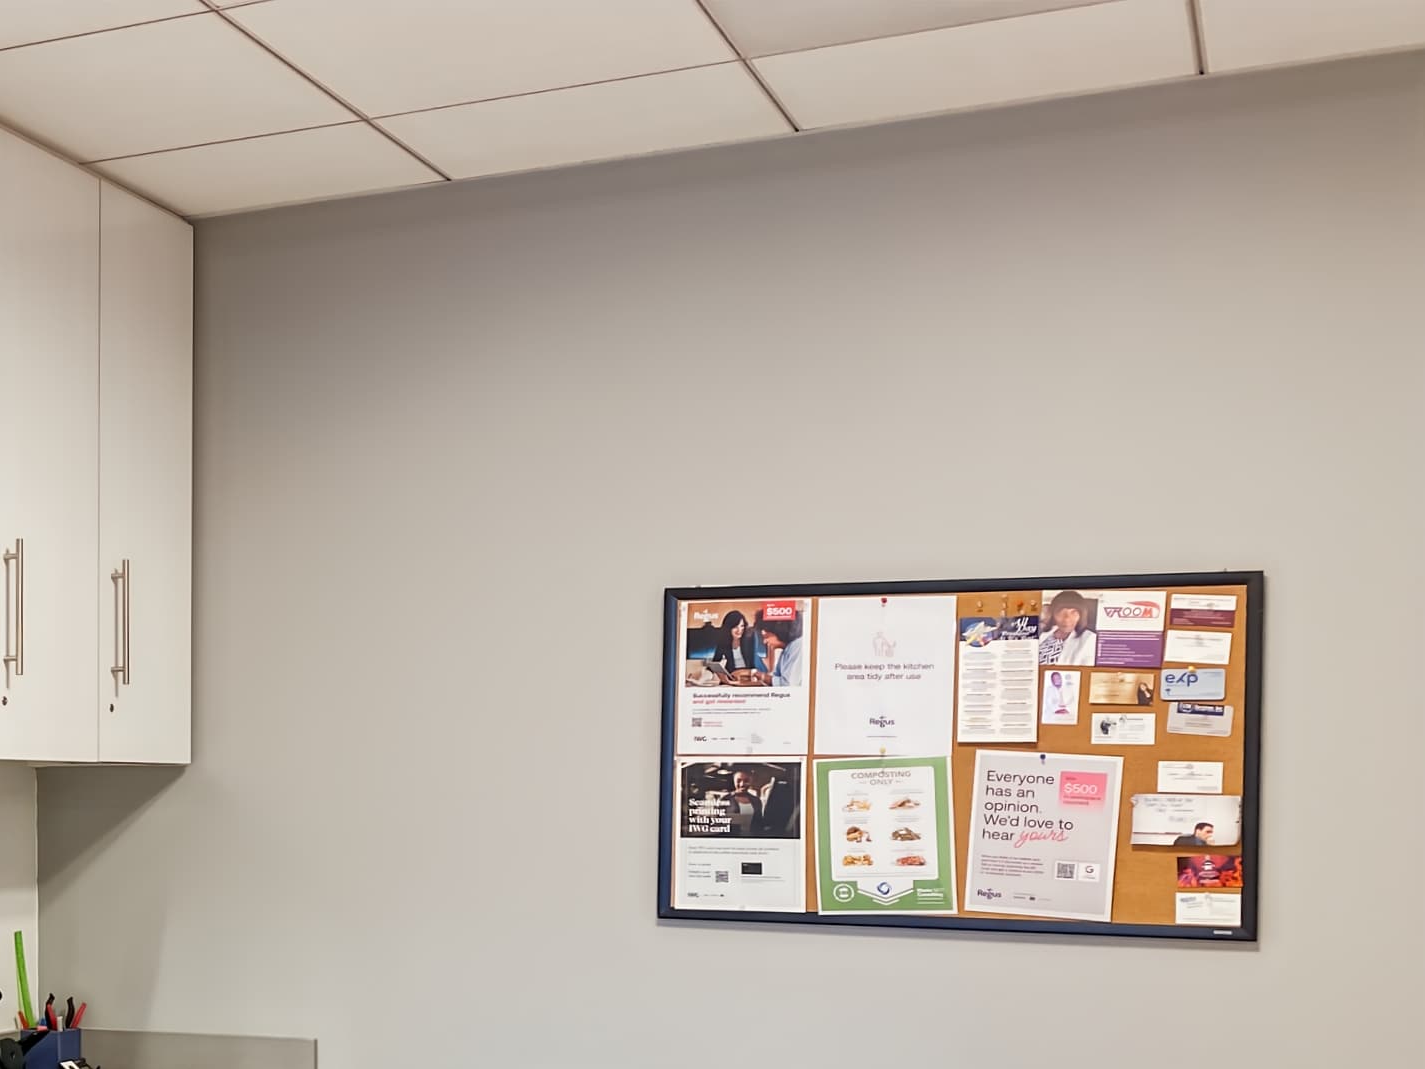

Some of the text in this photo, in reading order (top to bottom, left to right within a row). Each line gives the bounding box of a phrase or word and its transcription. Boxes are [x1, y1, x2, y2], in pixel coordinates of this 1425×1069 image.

[766, 607, 793, 616] $500
[864, 663, 885, 671] keep
[867, 673, 882, 681] tidy
[869, 717, 895, 728] Regus
[986, 770, 1055, 786] Everyone
[985, 785, 1035, 798] has an
[1064, 782, 1098, 795] $500
[688, 807, 726, 817] printing
[984, 801, 1042, 814] opinion.
[688, 816, 732, 825] with your
[983, 814, 1074, 831] We'd love to
[710, 824, 731, 833] card
[982, 828, 1069, 848] hear yours
